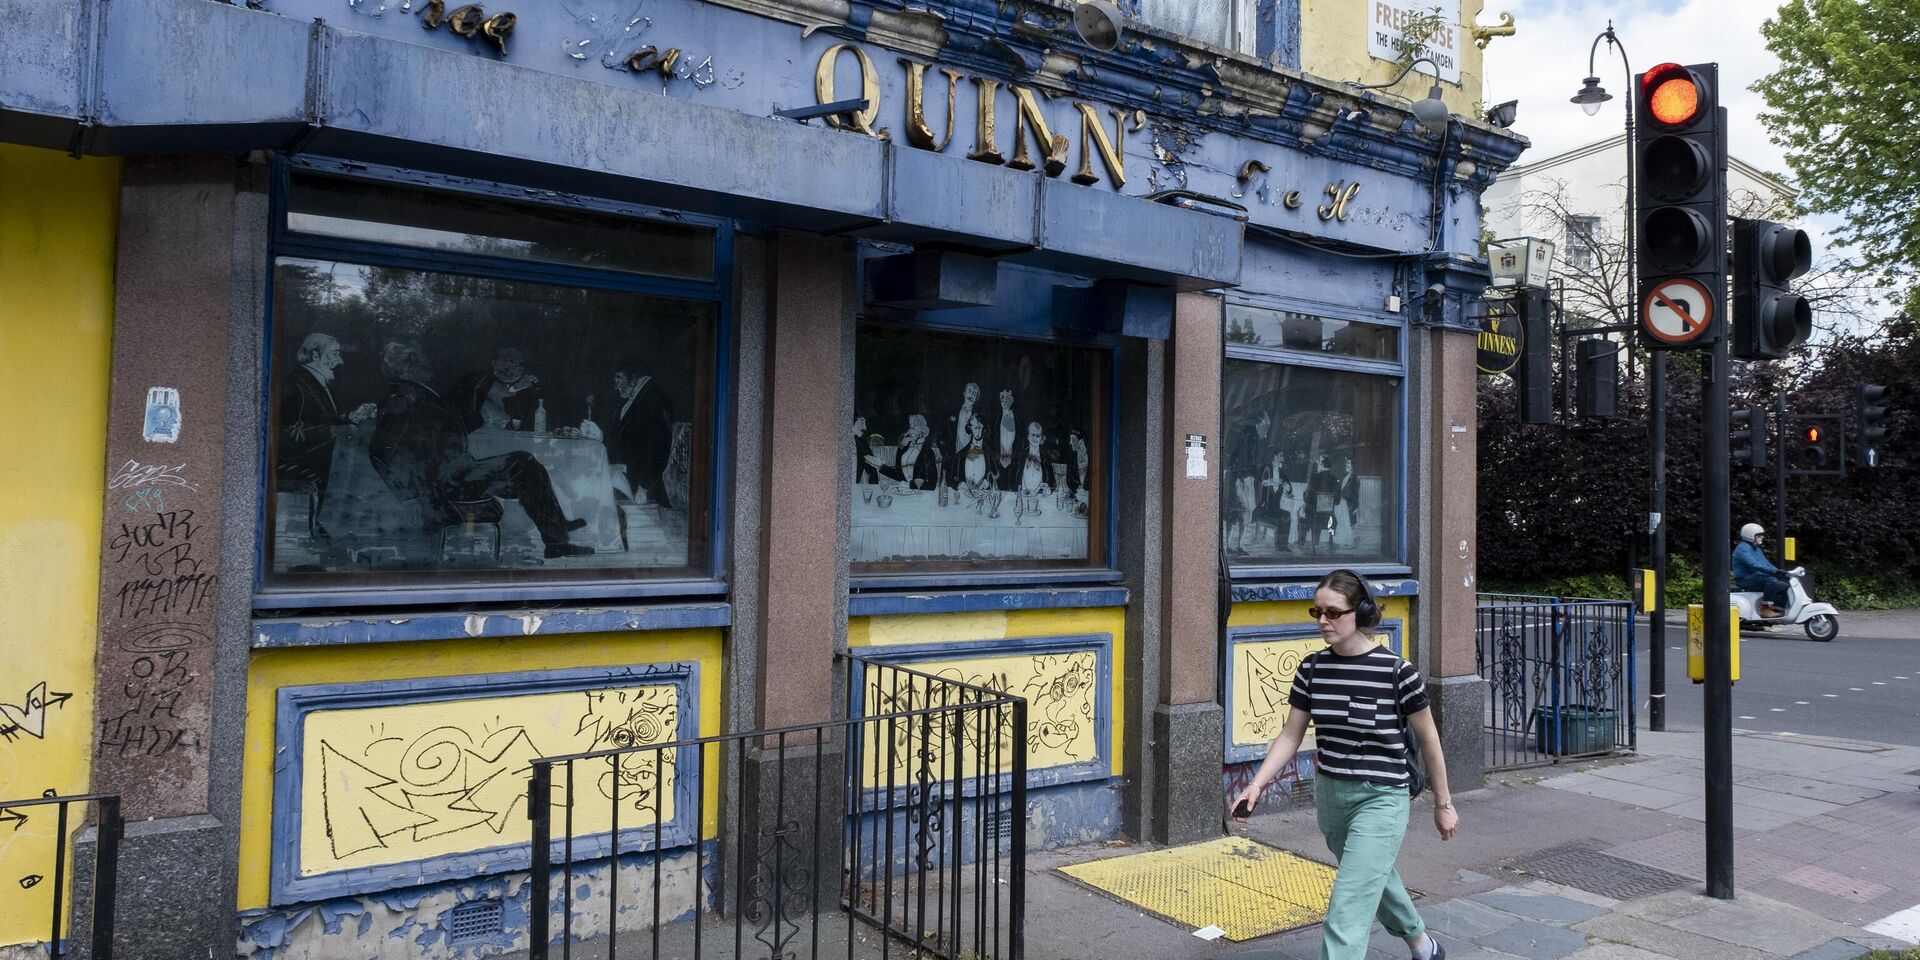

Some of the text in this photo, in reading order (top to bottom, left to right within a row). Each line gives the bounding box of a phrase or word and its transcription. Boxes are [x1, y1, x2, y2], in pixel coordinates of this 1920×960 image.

[1376, 32, 1388, 48] THE
[1426, 50, 1454, 70] CAMDEN
[1477, 331, 1516, 356] UINNESS
